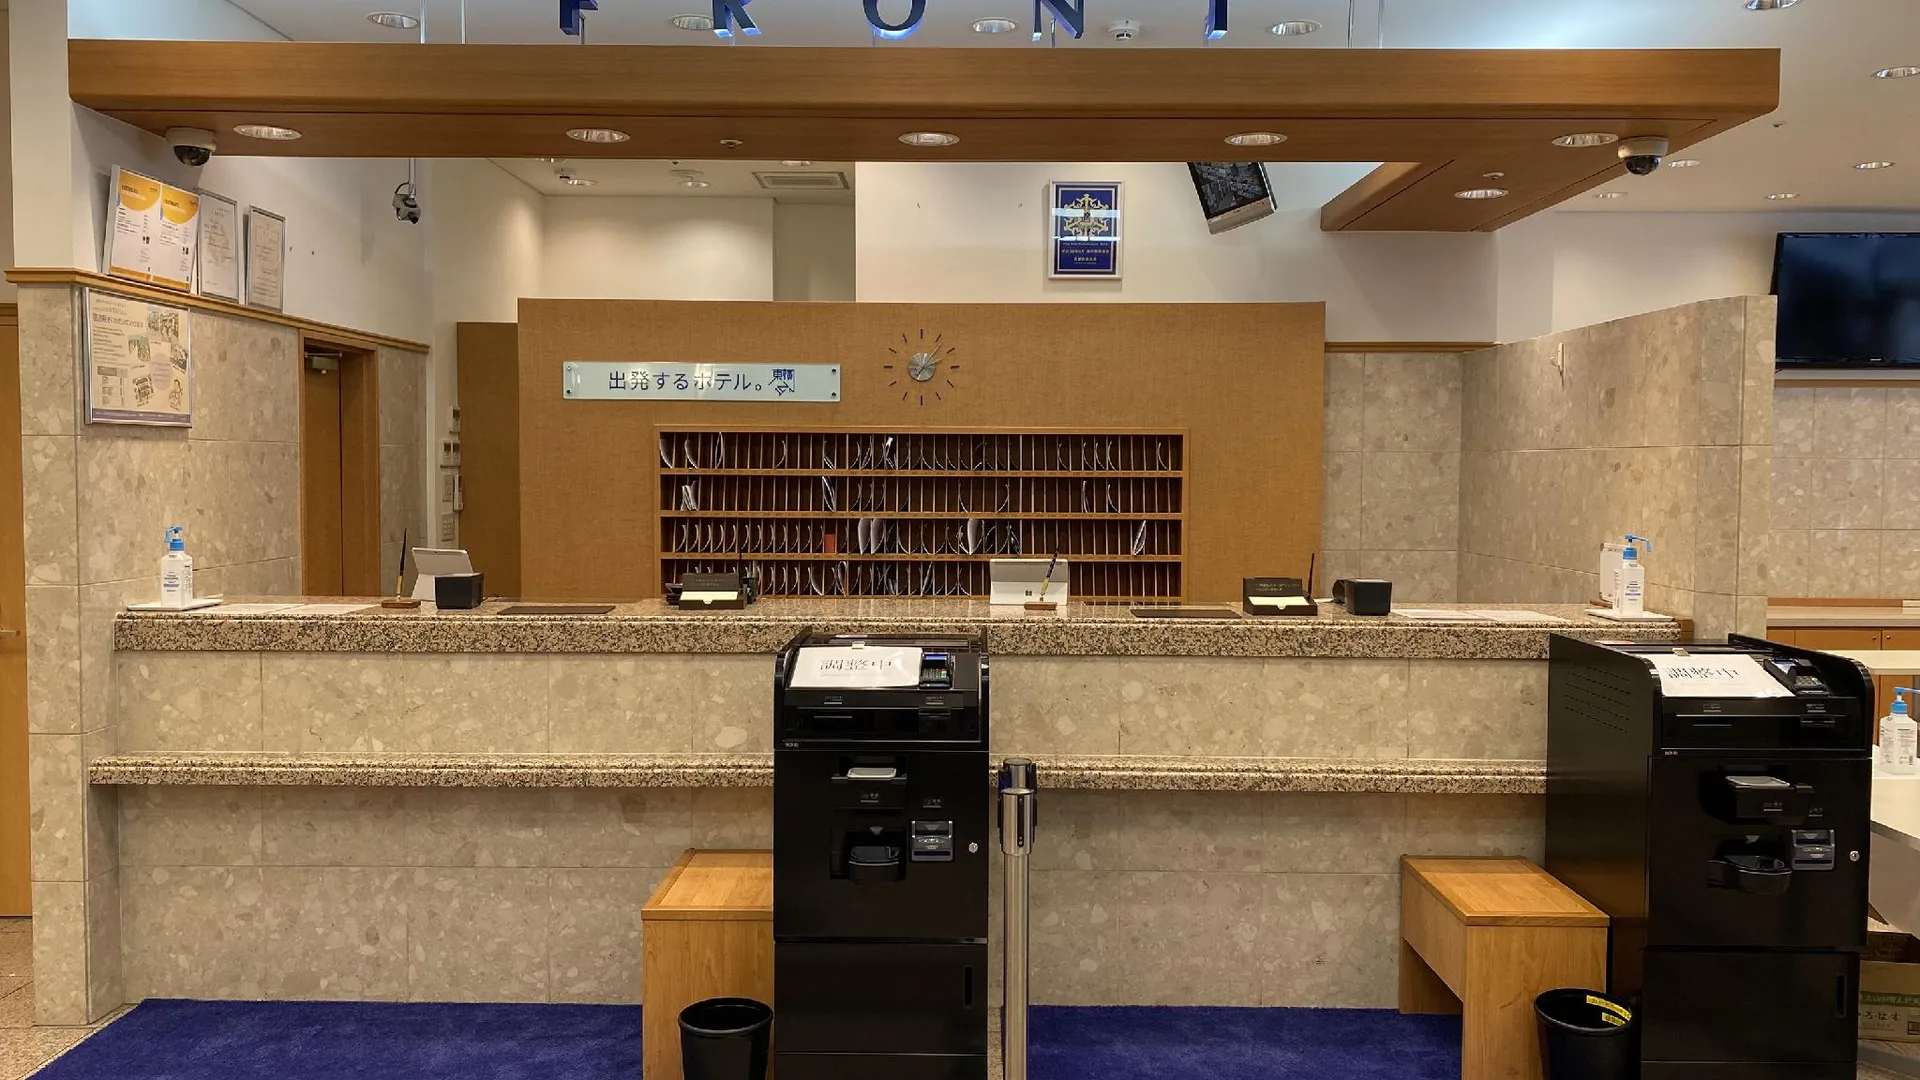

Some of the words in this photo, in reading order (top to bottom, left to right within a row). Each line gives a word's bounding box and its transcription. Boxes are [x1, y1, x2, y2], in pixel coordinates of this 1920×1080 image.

[608, 370, 762, 391] 出発するホテル。
[820, 659, 892, 671] 調整中
[1665, 666, 1739, 679] 調整中
